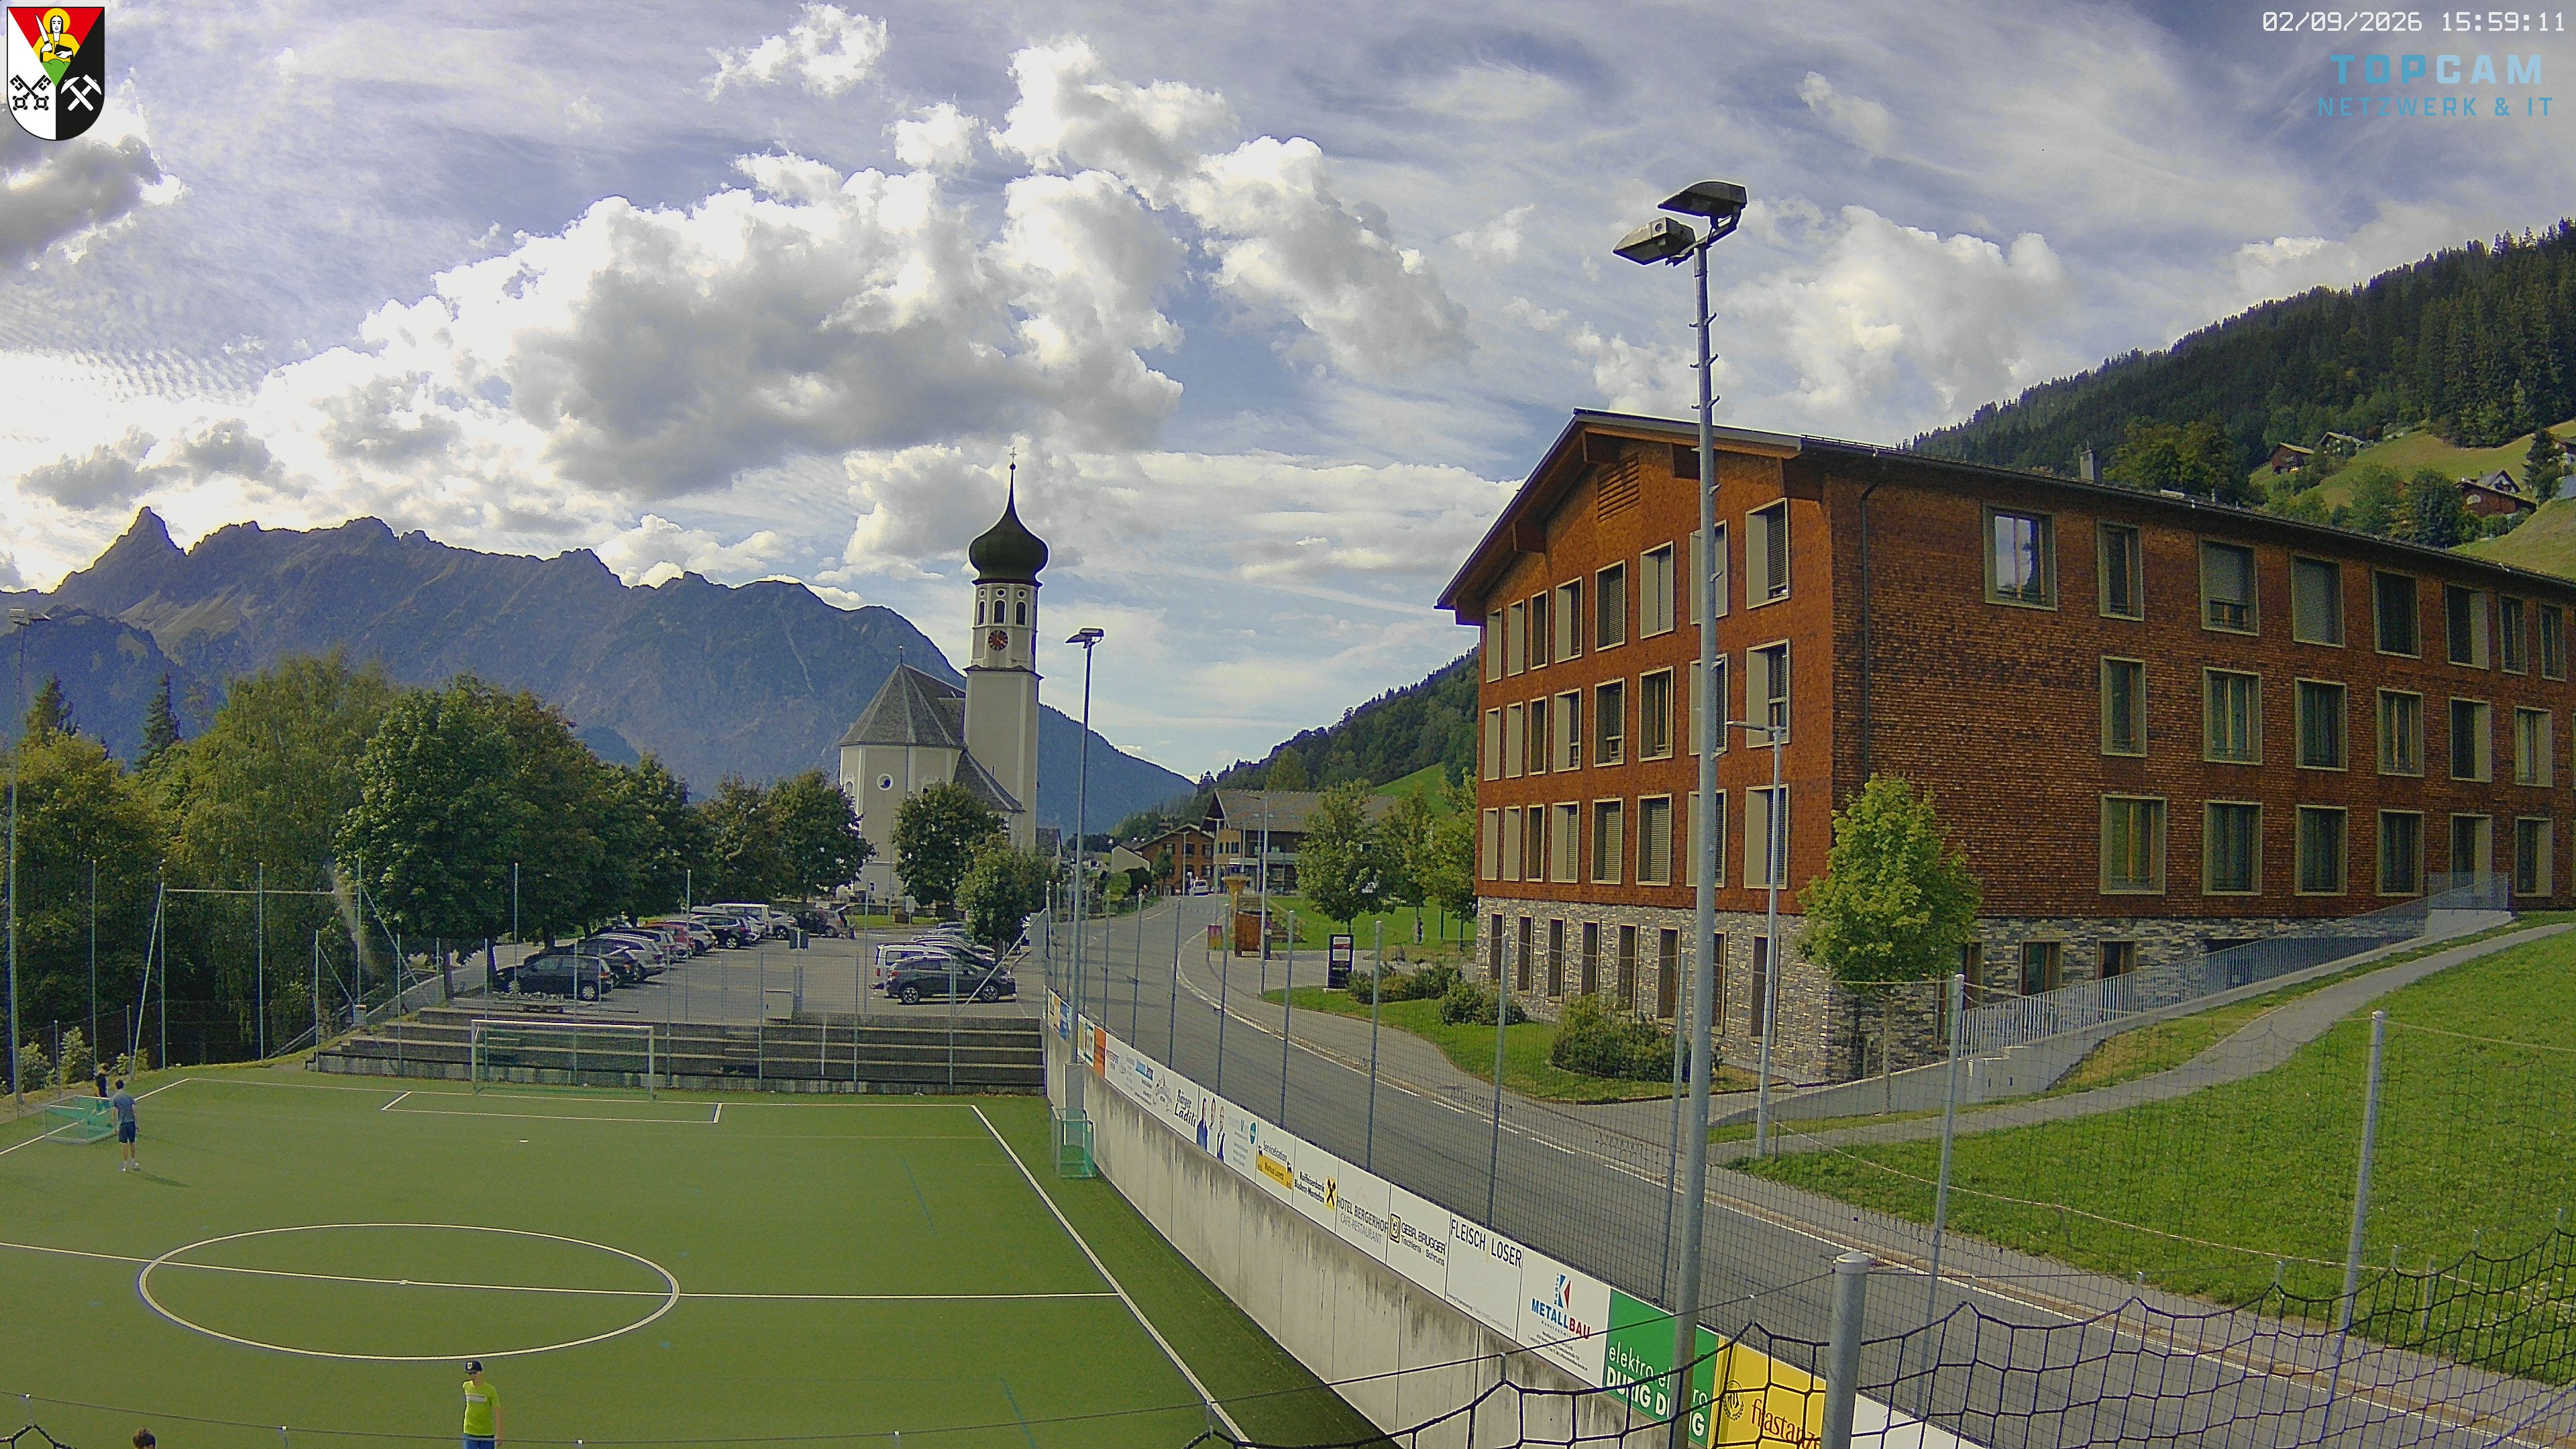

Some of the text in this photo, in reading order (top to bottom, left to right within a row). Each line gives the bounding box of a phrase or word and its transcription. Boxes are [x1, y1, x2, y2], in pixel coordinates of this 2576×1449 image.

[1337, 1196, 1353, 1215] HOTEL
[1354, 1205, 1388, 1234] BERGERHOF
[1401, 1222, 1417, 1240] GEBR.
[1418, 1231, 1446, 1255] BRUGGER
[1450, 1220, 1522, 1269] FLEISCH LOSER
[1532, 1298, 1591, 1340] METALLBAU
[1609, 1342, 1654, 1379] elektro
